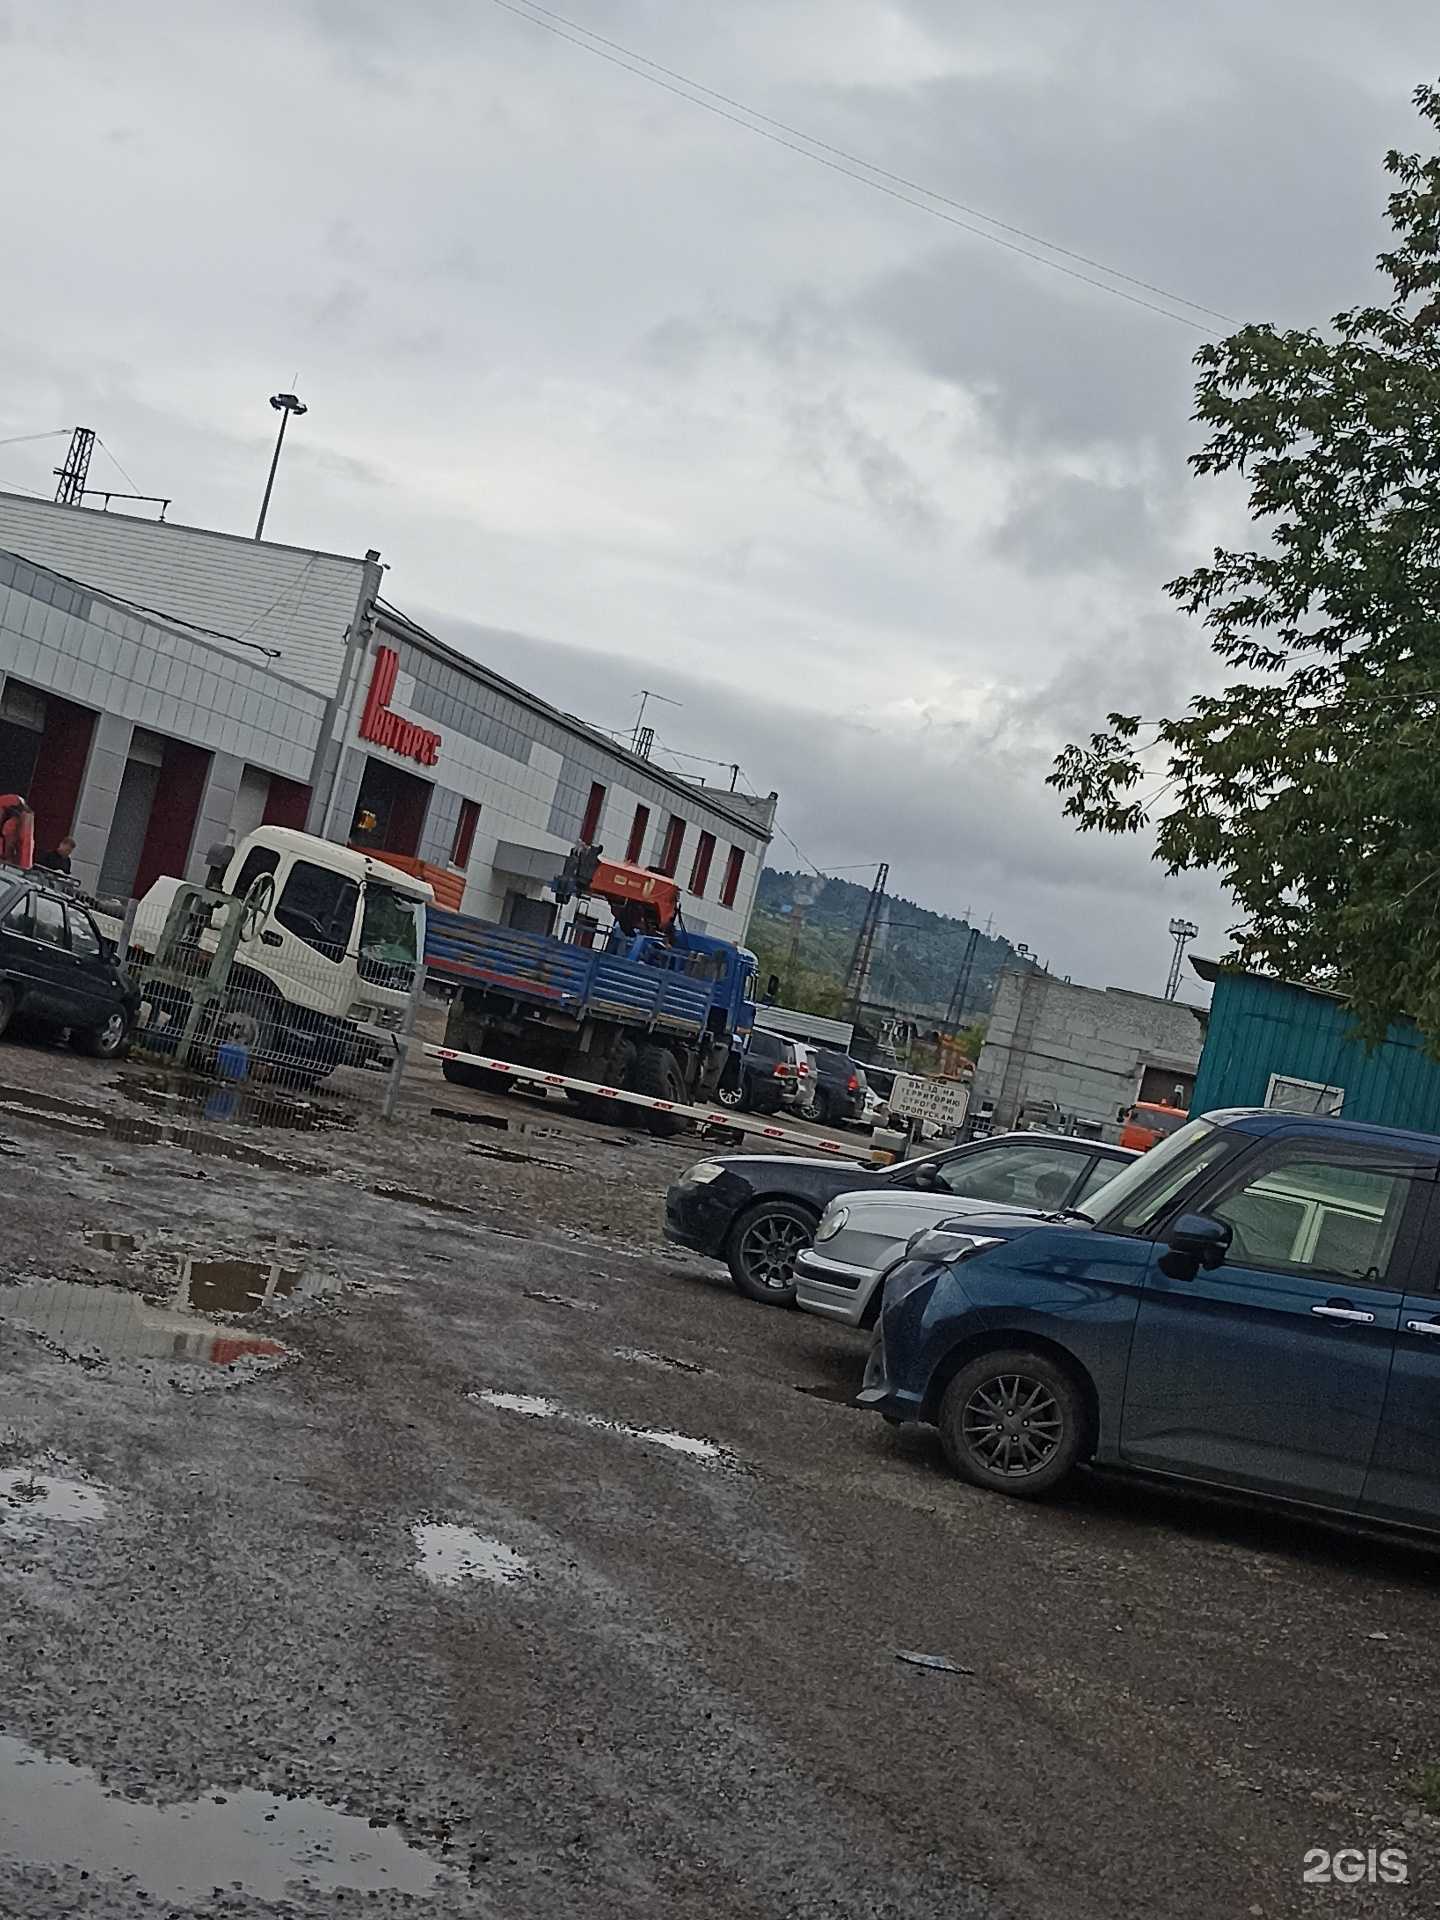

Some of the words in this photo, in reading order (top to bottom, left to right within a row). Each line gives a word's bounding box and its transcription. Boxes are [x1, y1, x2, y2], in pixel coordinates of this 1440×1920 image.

[364, 702, 442, 766] АНТАРЕС
[943, 1089, 955, 1097] НА
[898, 1104, 954, 1123] ПРОПУСКАМ
